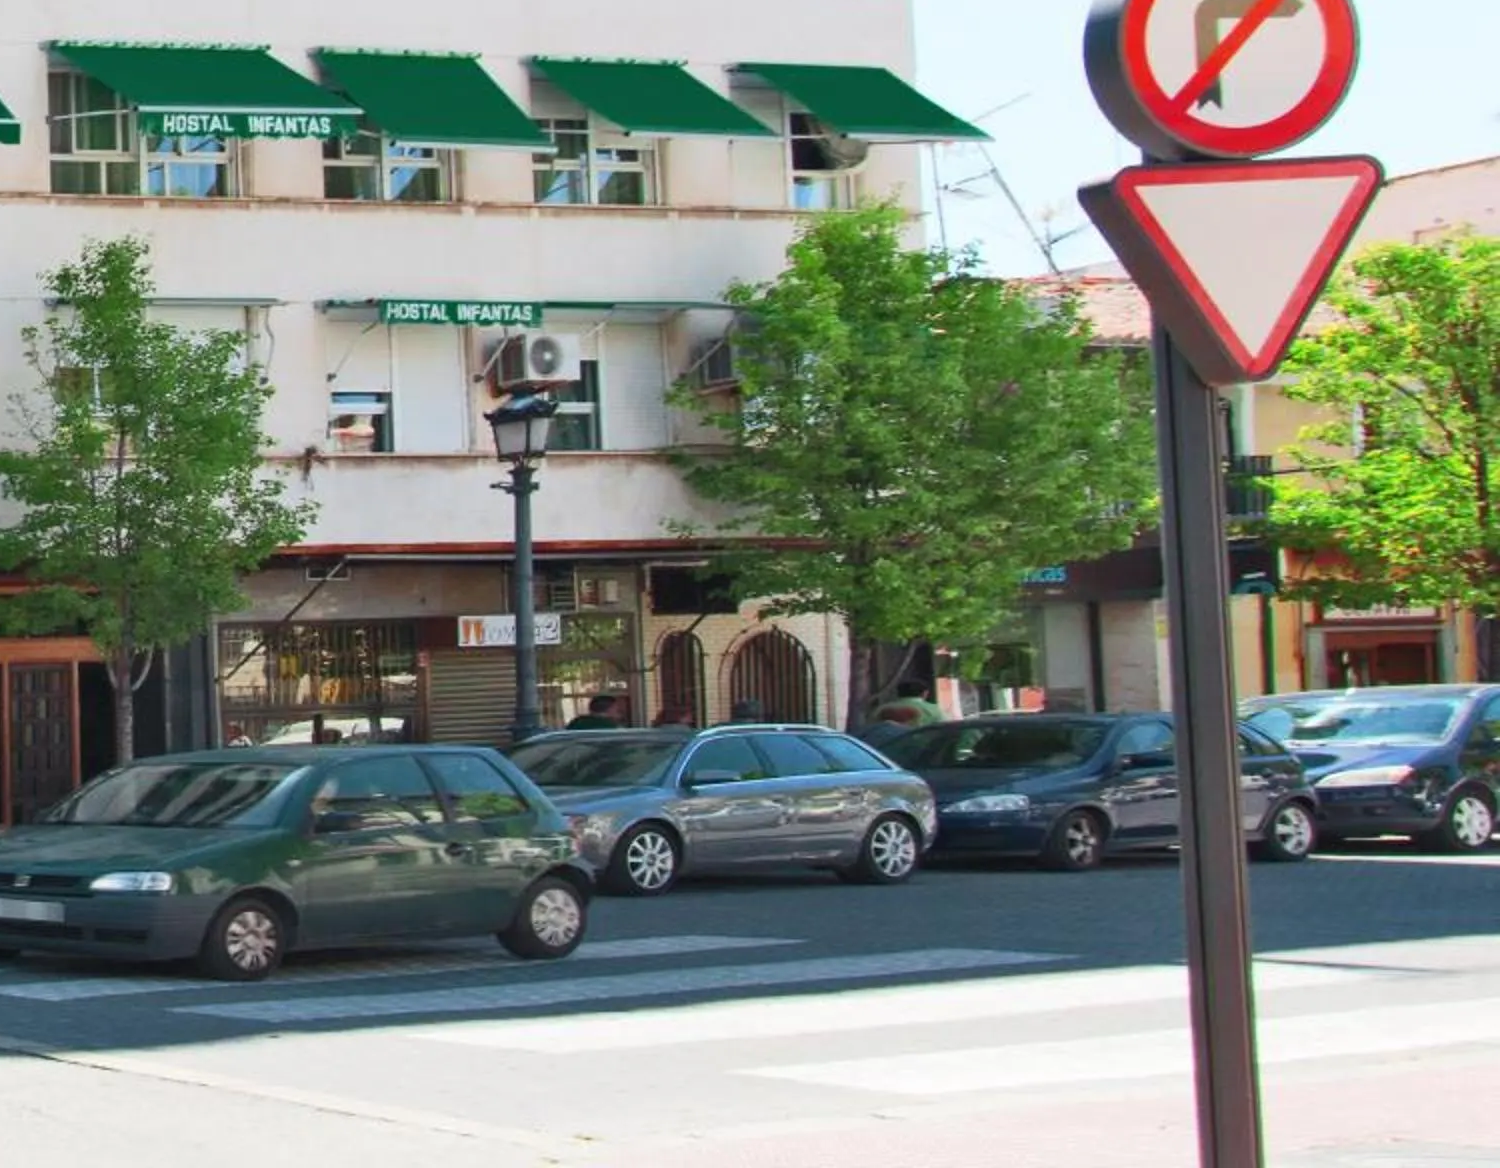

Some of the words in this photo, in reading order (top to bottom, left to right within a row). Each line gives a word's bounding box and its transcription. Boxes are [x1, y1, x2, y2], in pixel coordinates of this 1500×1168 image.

[162, 114, 235, 132] HOSTAL
[248, 116, 332, 134] INFANTAS
[387, 302, 449, 320] HOSTAL
[457, 304, 533, 321] INFANTAS
